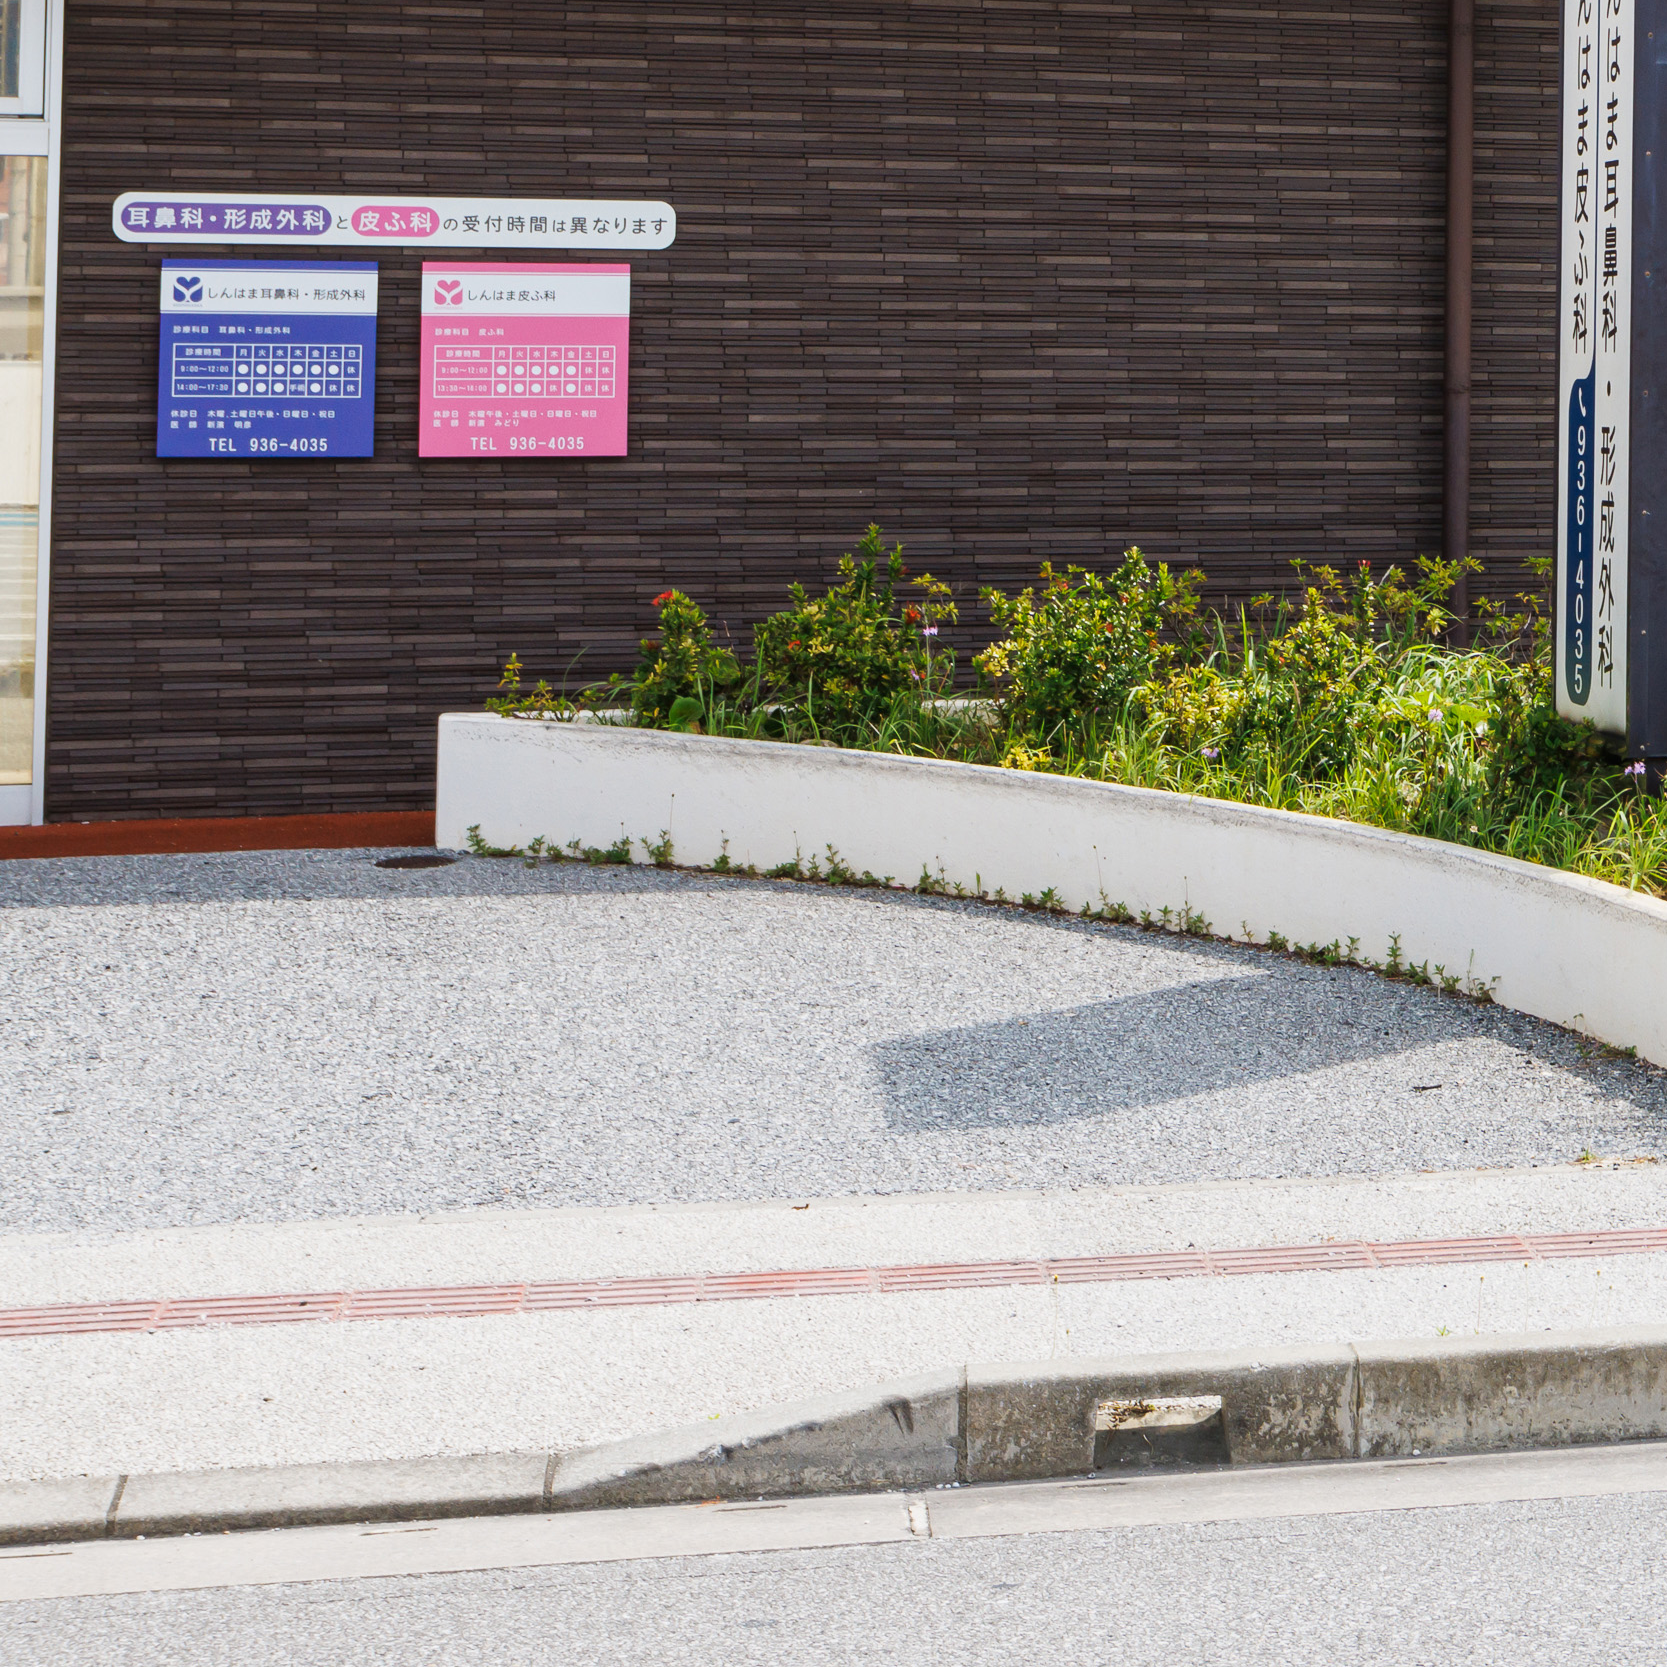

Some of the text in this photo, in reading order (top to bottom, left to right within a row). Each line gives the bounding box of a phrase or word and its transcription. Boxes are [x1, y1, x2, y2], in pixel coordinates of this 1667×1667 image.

[127, 206, 669, 237] 耳鼻科・形成外科と皮ふ科の受付時間は異なります
[207, 287, 366, 302] しんはま耳鼻科・形成外科
[467, 289, 557, 302] しんはま皮ふ科
[209, 437, 329, 452] TEL 936-4035
[470, 436, 585, 451] TEL 936-4035
[1574, 424, 1585, 694] 936-4035
